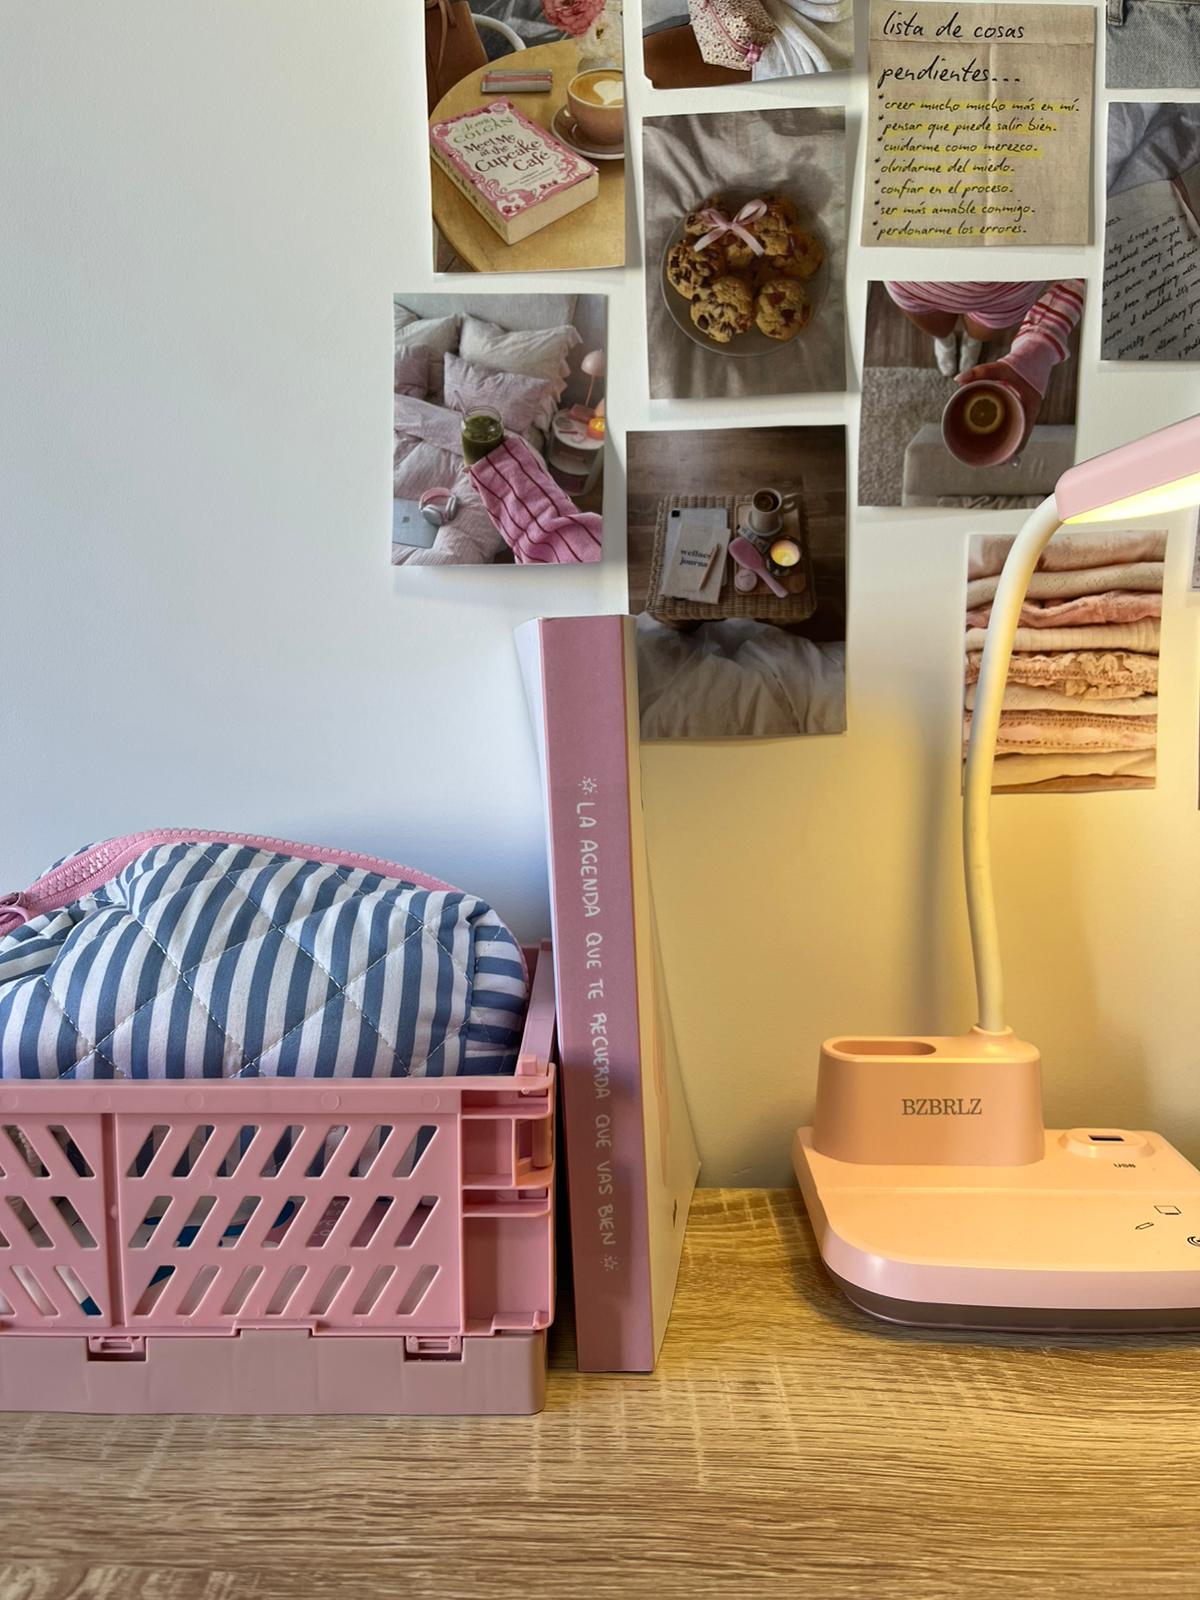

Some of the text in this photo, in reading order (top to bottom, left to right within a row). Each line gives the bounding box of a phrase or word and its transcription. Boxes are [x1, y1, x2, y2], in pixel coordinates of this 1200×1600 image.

[883, 10, 1025, 39] lista de cosas
[877, 55, 1021, 89] pendientes...
[885, 101, 915, 110] creer
[920, 98, 961, 112] mucho
[966, 98, 1006, 112] mucho
[1012, 98, 1035, 111] más
[1040, 103, 1054, 112] en
[882, 116, 1057, 139] pensar que puede salir bien.
[463, 134, 516, 154] Meet Me
[480, 145, 509, 157] at the
[883, 137, 1039, 153] cuidarme como merezco.
[474, 138, 542, 172] Cupcake
[880, 157, 1016, 174] olvidarme del miedo.
[880, 178, 1014, 199] confiar en el proceso.
[880, 200, 1036, 222] ser más amable conmigo.
[876, 220, 1027, 240] perdonarme los errores.
[679, 557, 709, 567] journa
[576, 802, 617, 1246] LA AGENDA QUE TE RECUERDA QUE VAS BIEN
[902, 1098, 983, 1116] BZBRLZ
